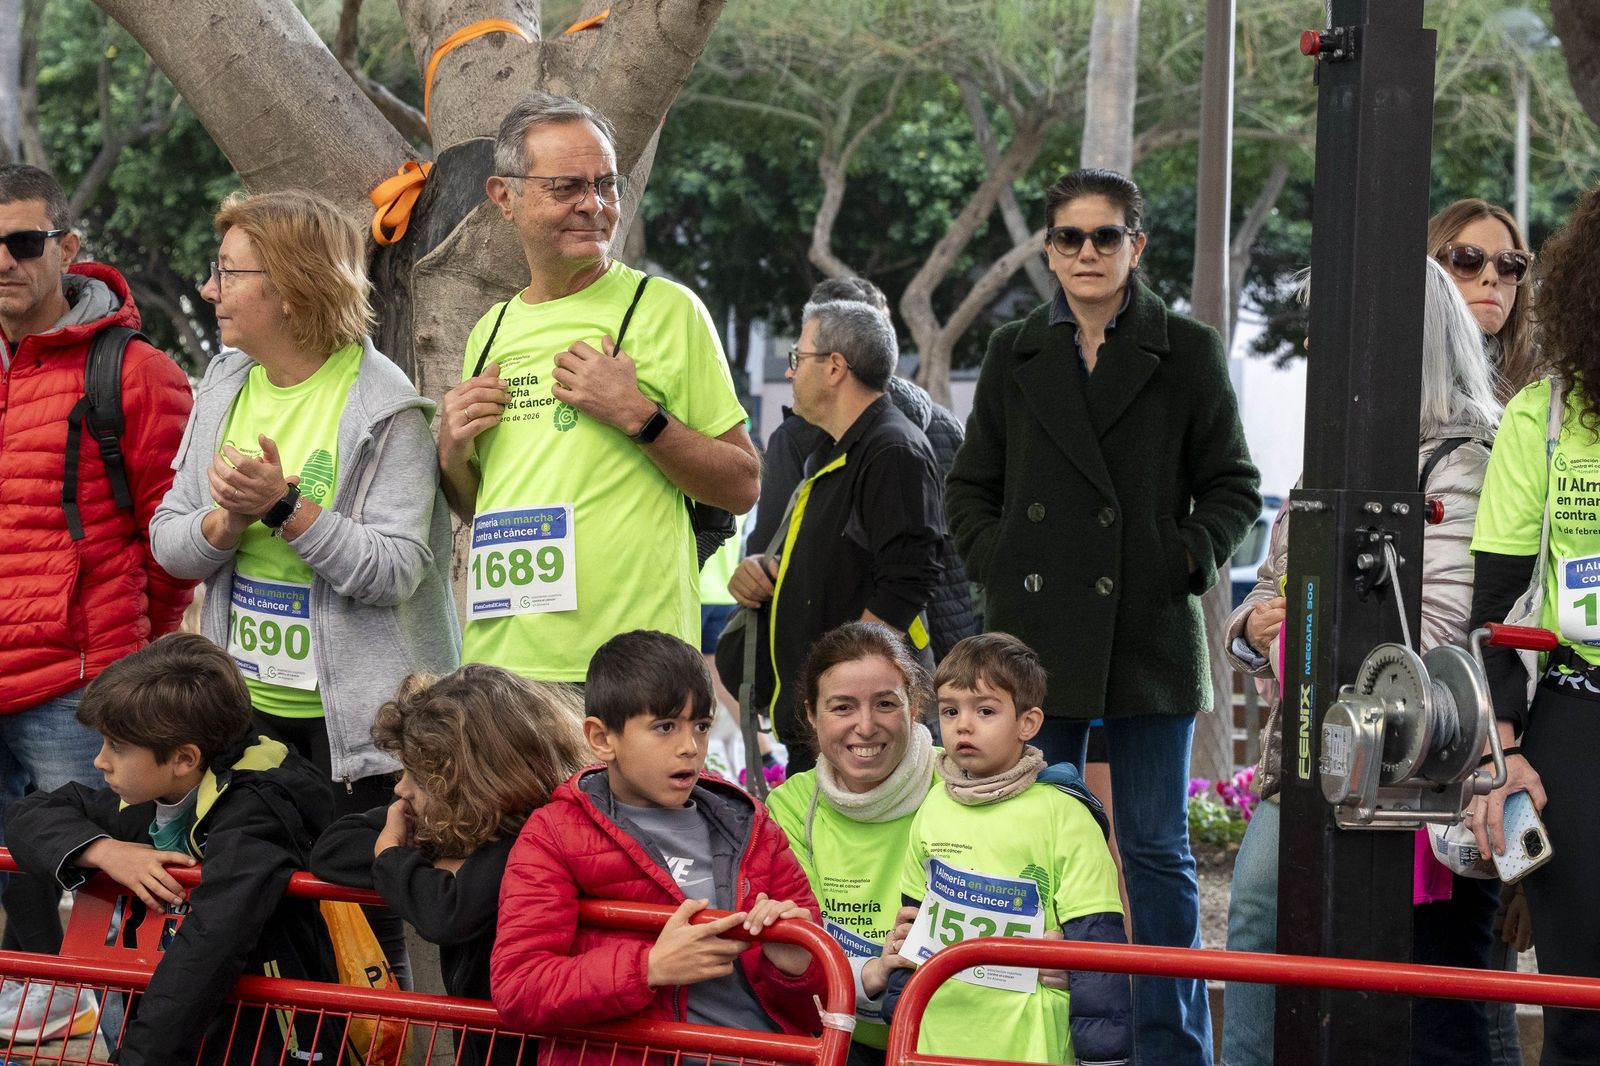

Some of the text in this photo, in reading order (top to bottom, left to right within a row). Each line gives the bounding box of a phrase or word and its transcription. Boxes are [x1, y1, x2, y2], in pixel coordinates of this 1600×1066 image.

[507, 398, 516, 410] el
[523, 412, 540, 420] 2026
[1558, 477, 1567, 491] II
[1557, 496, 1571, 505] en
[499, 516, 512, 526] en
[514, 513, 554, 525] marcha
[1555, 510, 1597, 520] contra
[494, 530, 502, 539] el
[503, 527, 538, 538] cáncer
[472, 546, 564, 590] 1689
[1576, 561, 1600, 573] II Al
[254, 588, 265, 596] en
[267, 589, 304, 600] marcha
[248, 597, 256, 606] el
[257, 599, 289, 611] cáncer
[1573, 592, 1598, 626] 1
[232, 610, 310, 660] 1690
[1298, 683, 1312, 780] FENIX
[935, 881, 1010, 908] contra el cáncer
[968, 881, 982, 890] en
[985, 882, 1027, 897] marcha
[825, 898, 881, 912] Almería
[838, 934, 872, 954] Almería
